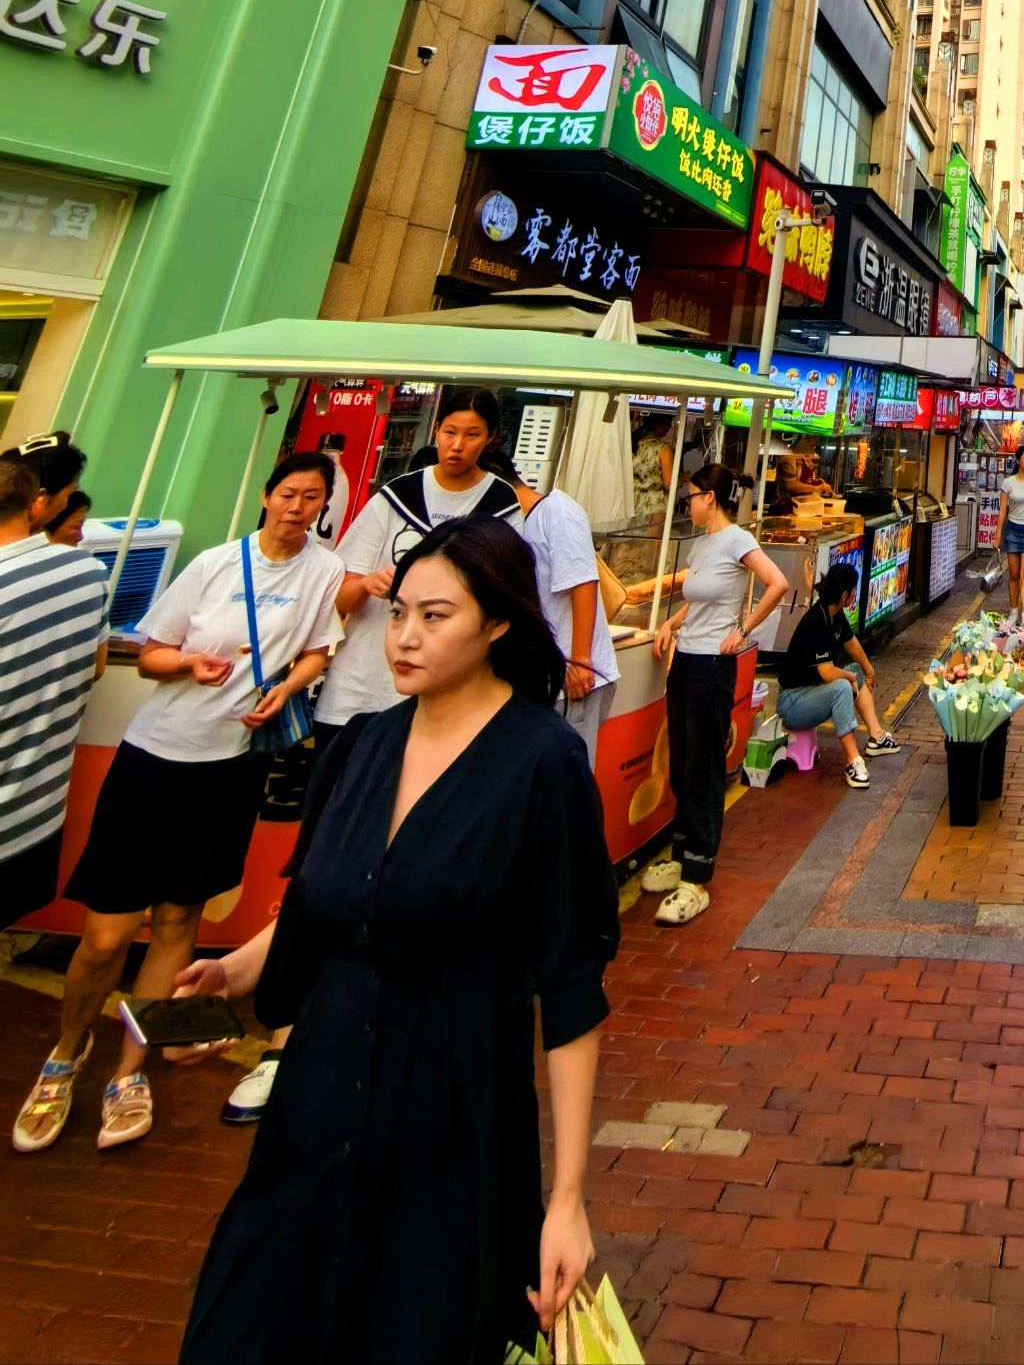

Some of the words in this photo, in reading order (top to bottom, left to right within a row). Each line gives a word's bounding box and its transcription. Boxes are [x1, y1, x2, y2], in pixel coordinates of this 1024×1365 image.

[487, 48, 607, 111] 面
[474, 114, 597, 145] 煲仔饭
[671, 106, 745, 183] 明火煲仔饭
[679, 149, 733, 203] 饭比肉还香
[879, 254, 930, 335] 浙温眼镜
[801, 387, 829, 417] 腿
[980, 497, 1000, 511] 手机
